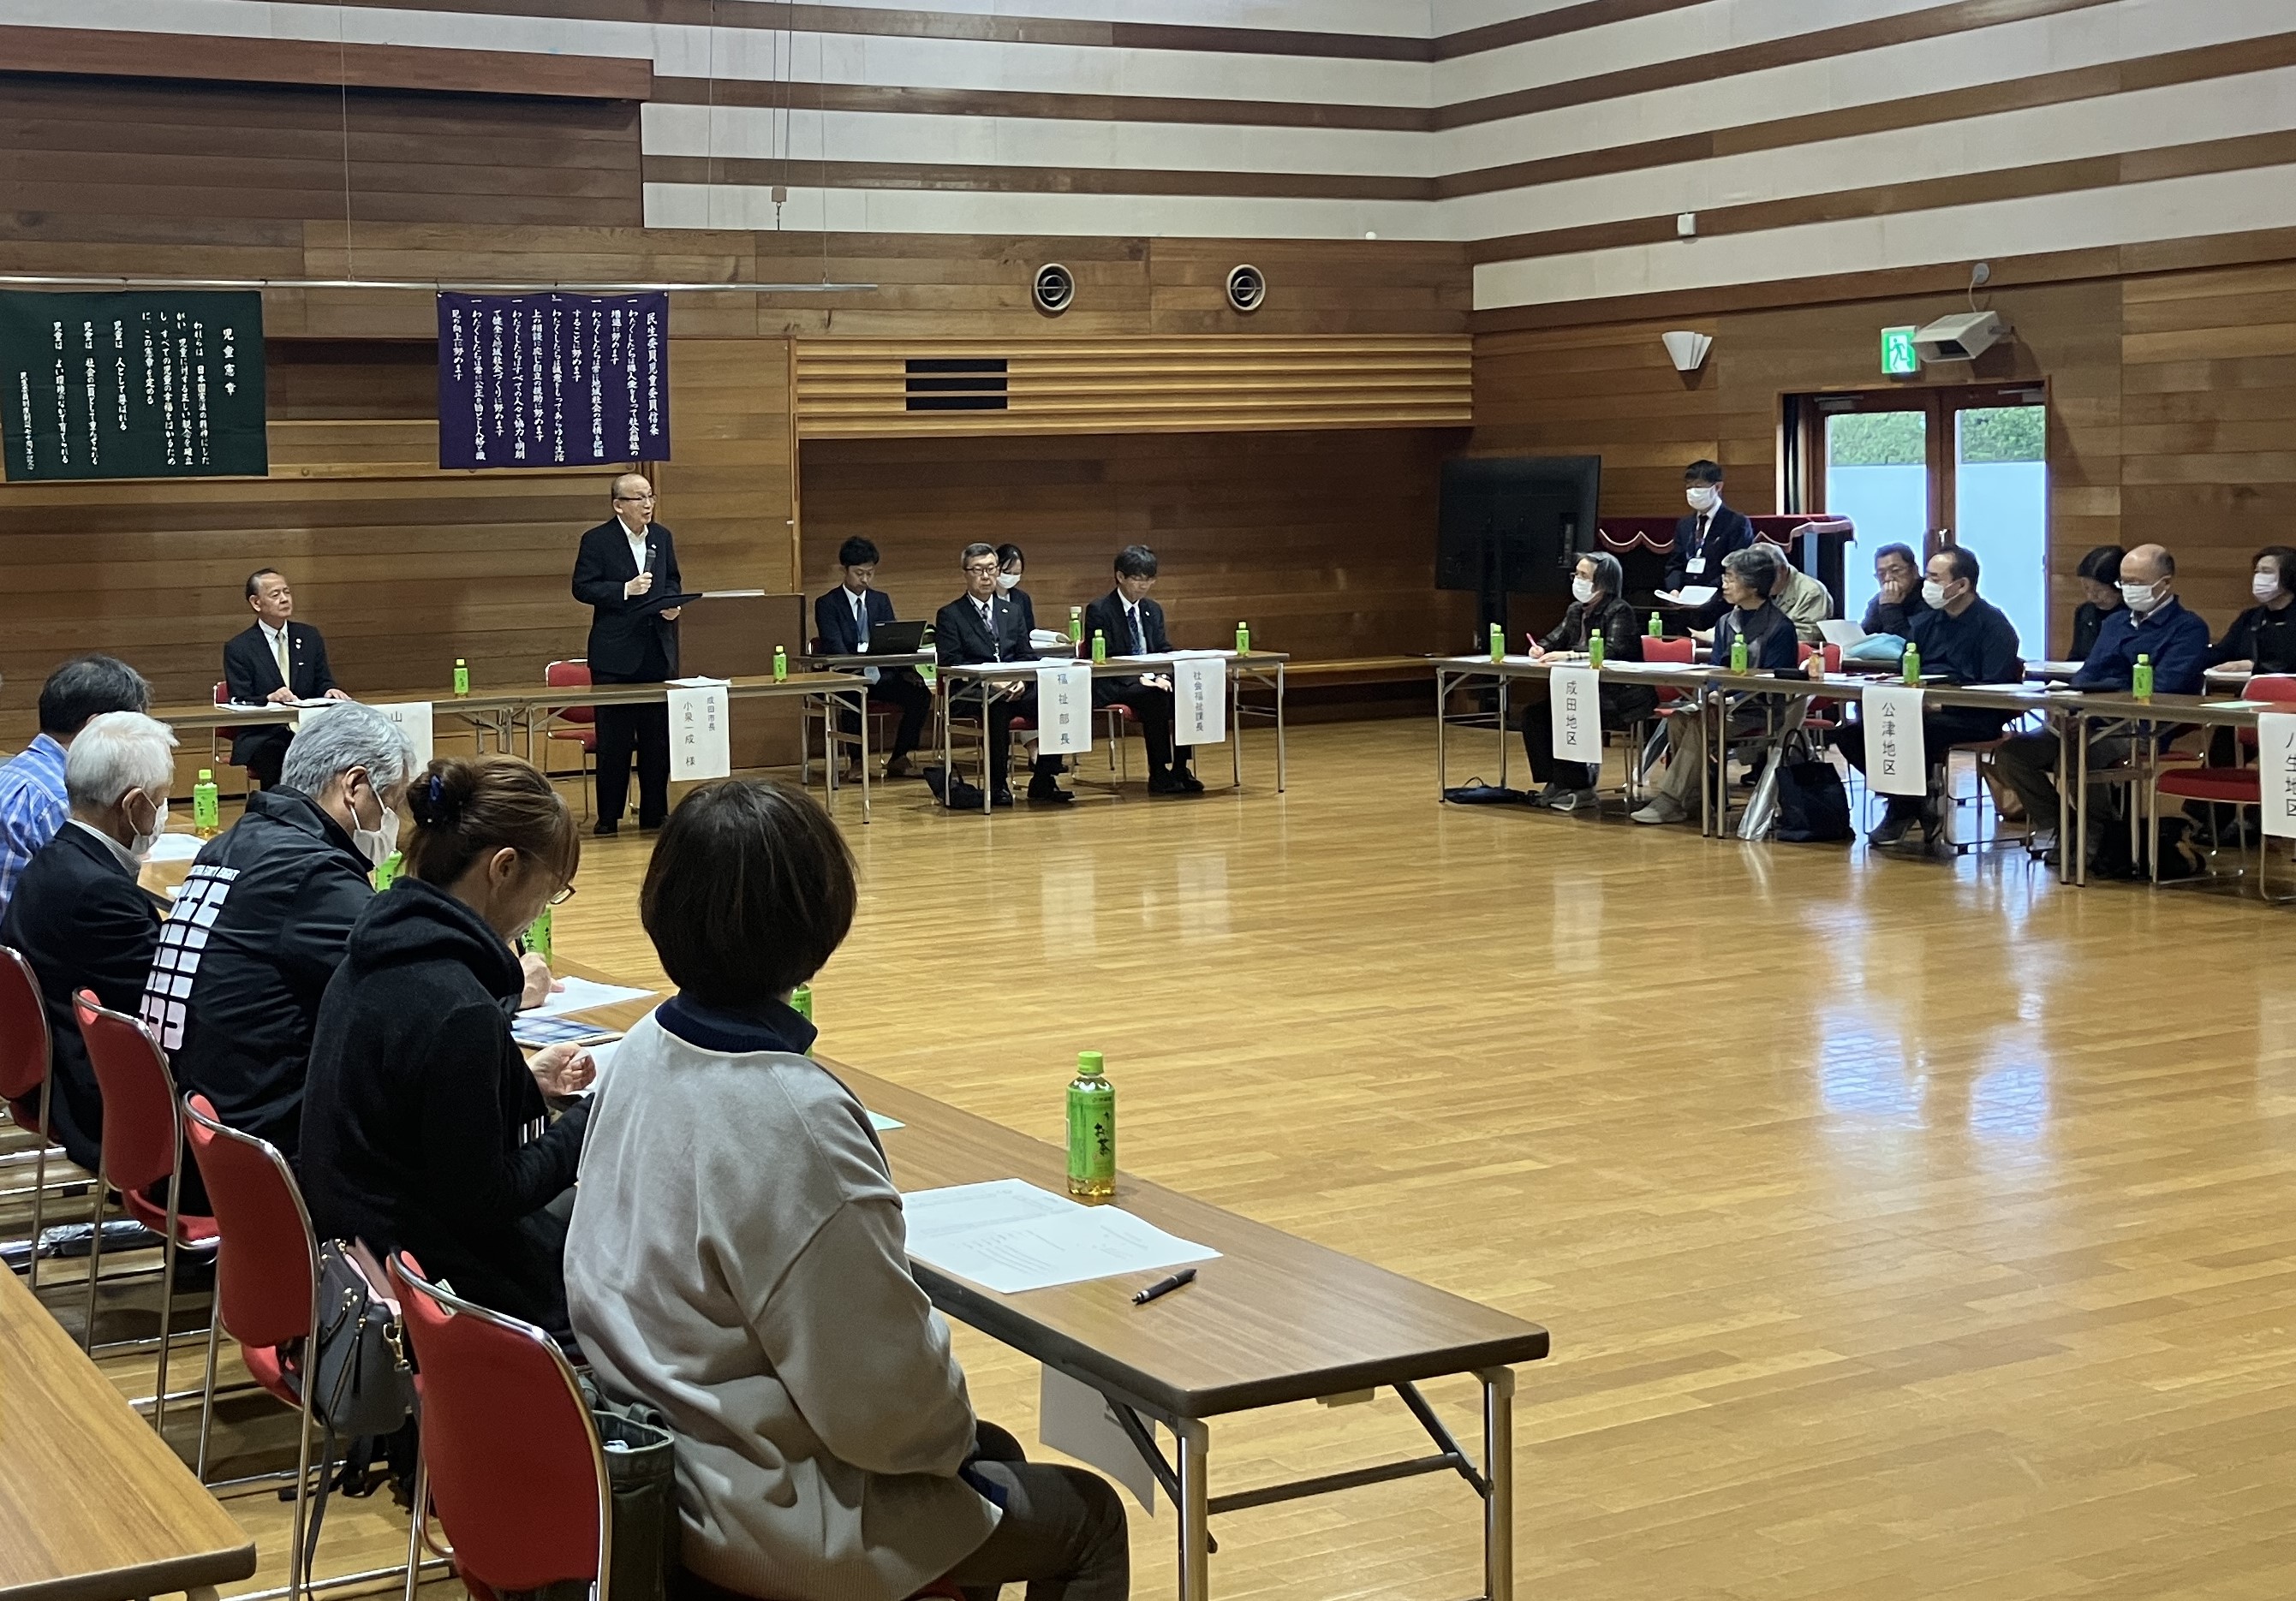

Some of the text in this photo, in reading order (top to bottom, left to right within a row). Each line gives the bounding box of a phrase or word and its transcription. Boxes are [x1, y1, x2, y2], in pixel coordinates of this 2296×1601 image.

[647, 312, 659, 436] 民生委員児童委員信条
[683, 701, 695, 744] 小泉一成
[1058, 674, 1070, 745] 福祉部長
[1194, 671, 1203, 731] 社会福祉課長
[1566, 681, 1577, 745] 成田地区
[1882, 702, 1896, 775] 公津地区
